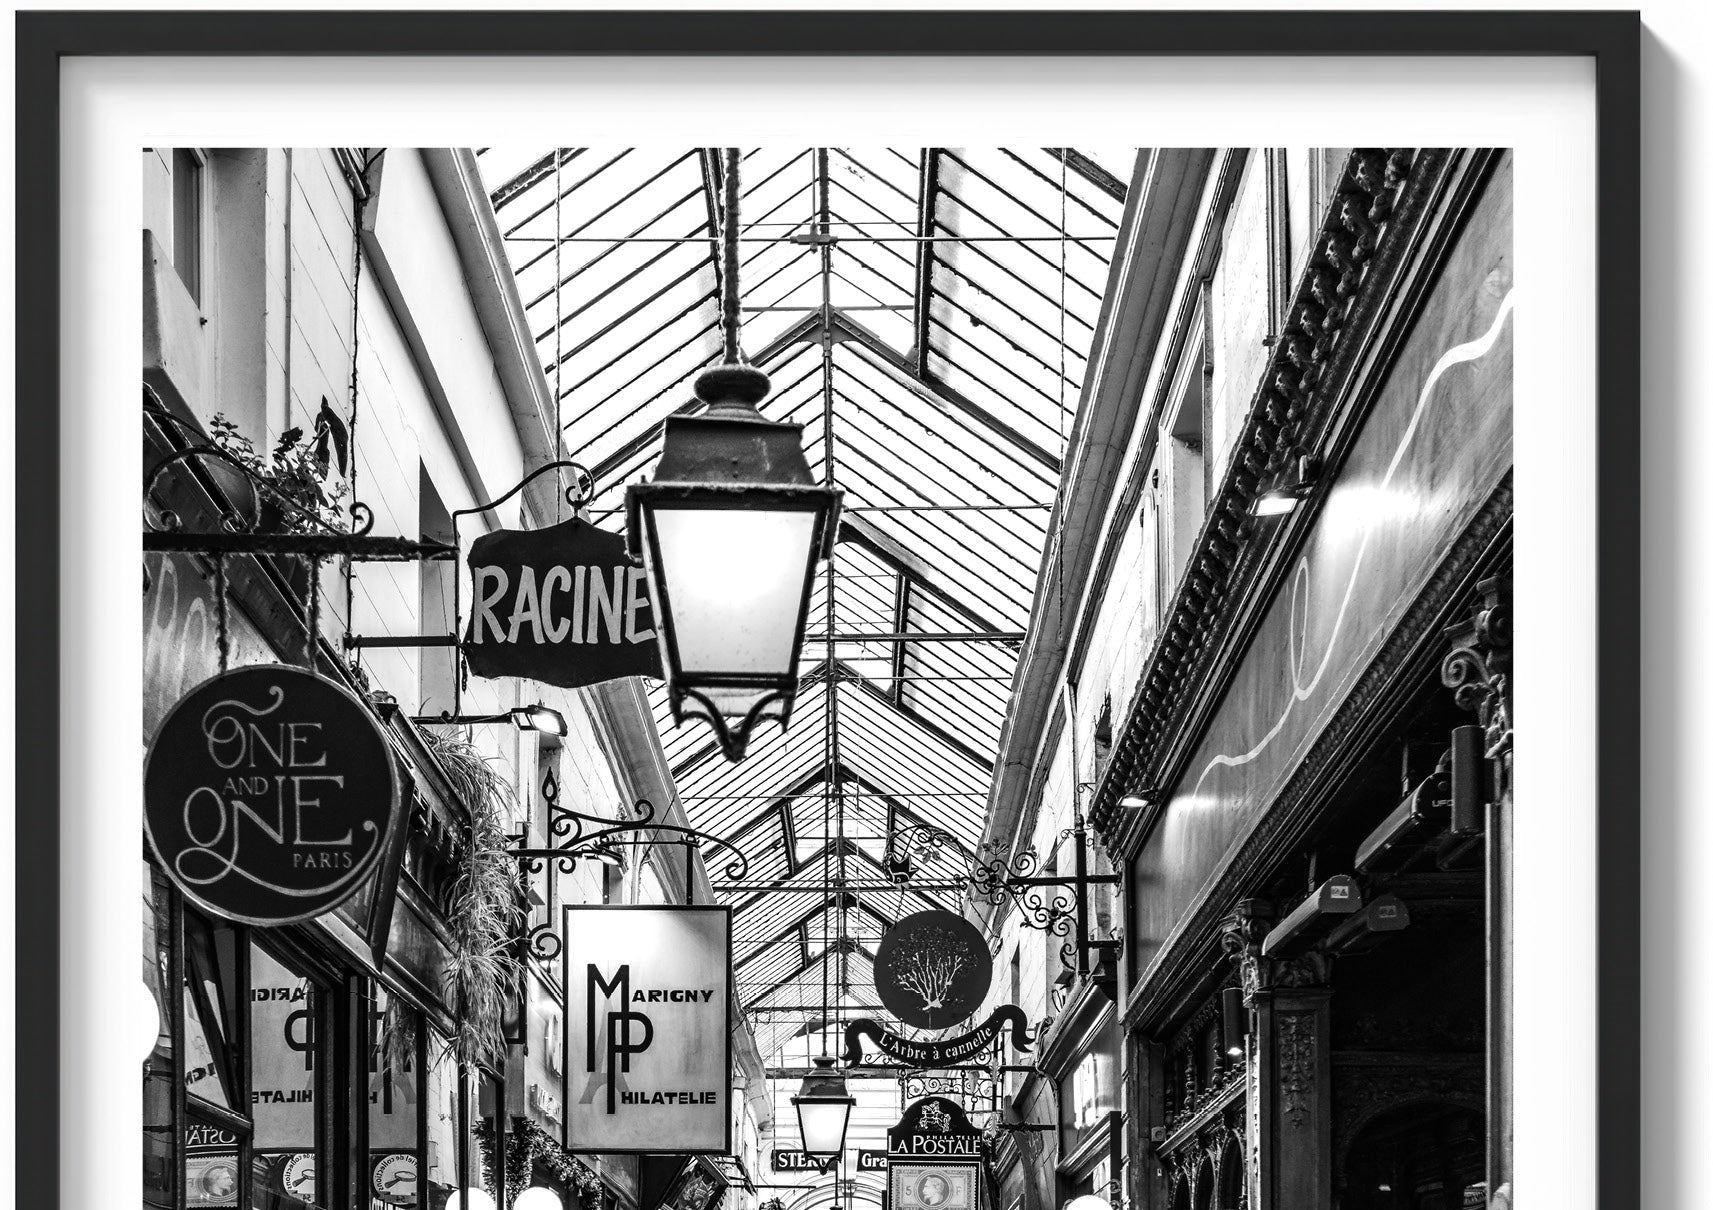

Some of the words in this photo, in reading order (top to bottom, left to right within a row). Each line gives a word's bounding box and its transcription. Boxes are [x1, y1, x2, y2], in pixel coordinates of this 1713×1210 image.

[472, 564, 657, 646] RACINE
[203, 686, 327, 769] ONE
[222, 775, 268, 796] AND
[178, 775, 360, 872] ONE
[293, 852, 353, 869] PARIS
[878, 1031, 927, 1061] L'Arbre
[932, 1047, 940, 1061] à
[945, 1026, 994, 1060] cannelle
[888, 1134, 909, 1154] LA
[912, 1134, 981, 1155] POSTALE
[905, 1185, 912, 1196] 5
